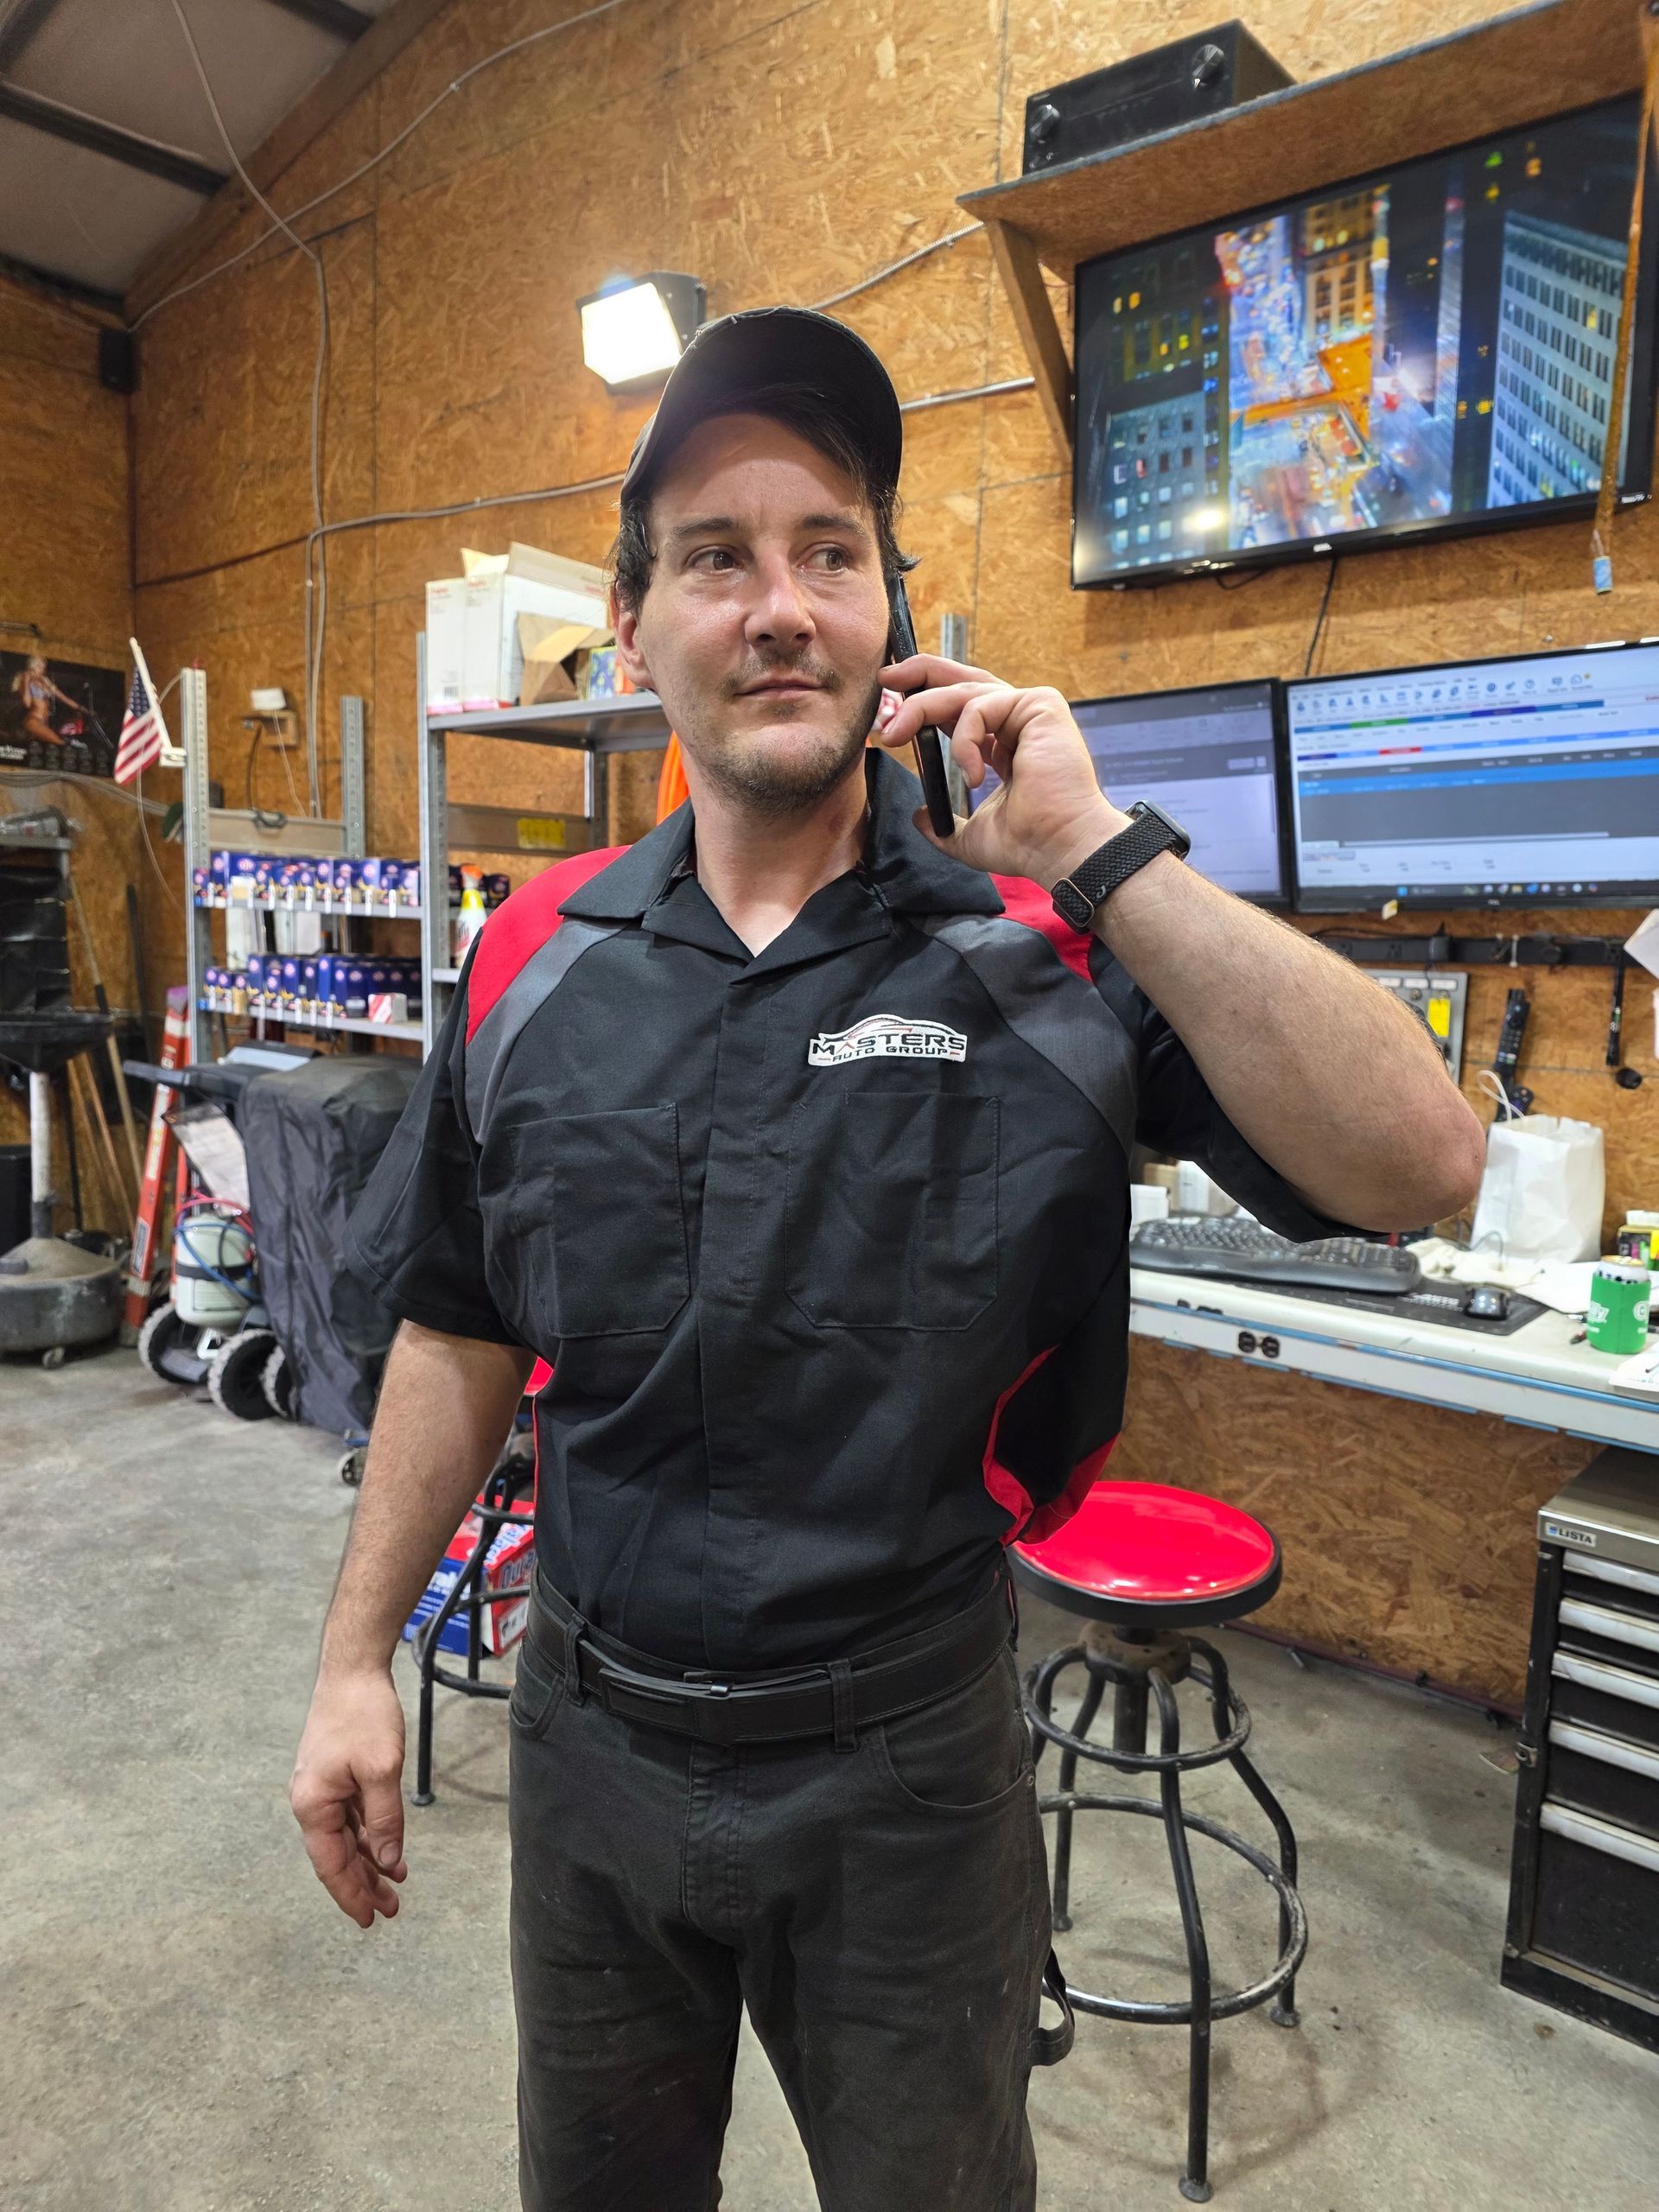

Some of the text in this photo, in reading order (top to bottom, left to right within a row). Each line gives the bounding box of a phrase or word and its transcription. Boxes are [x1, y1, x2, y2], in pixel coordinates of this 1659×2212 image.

[812, 1033, 965, 1056] MASTERS
[832, 1046, 948, 1063] AUTO GROUP
[1559, 1527, 1592, 1543] LISTA
